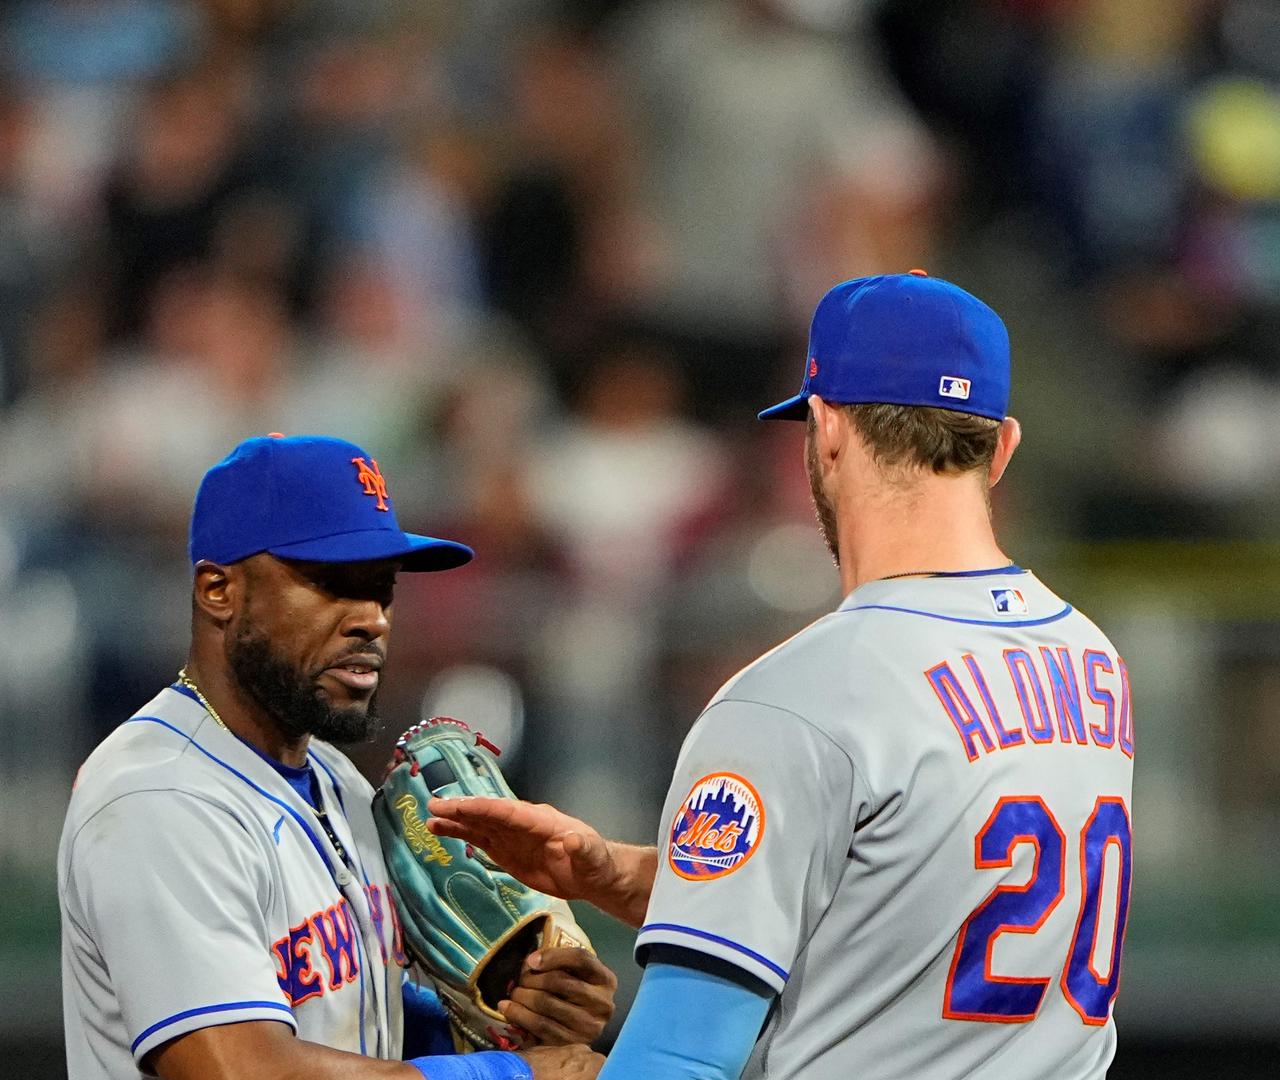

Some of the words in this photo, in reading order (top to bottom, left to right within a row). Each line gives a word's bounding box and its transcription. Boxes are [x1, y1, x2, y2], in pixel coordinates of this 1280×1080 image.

[923, 645, 1136, 763] ALONSO
[677, 811, 744, 853] Mets
[942, 795, 1133, 1026] 20
